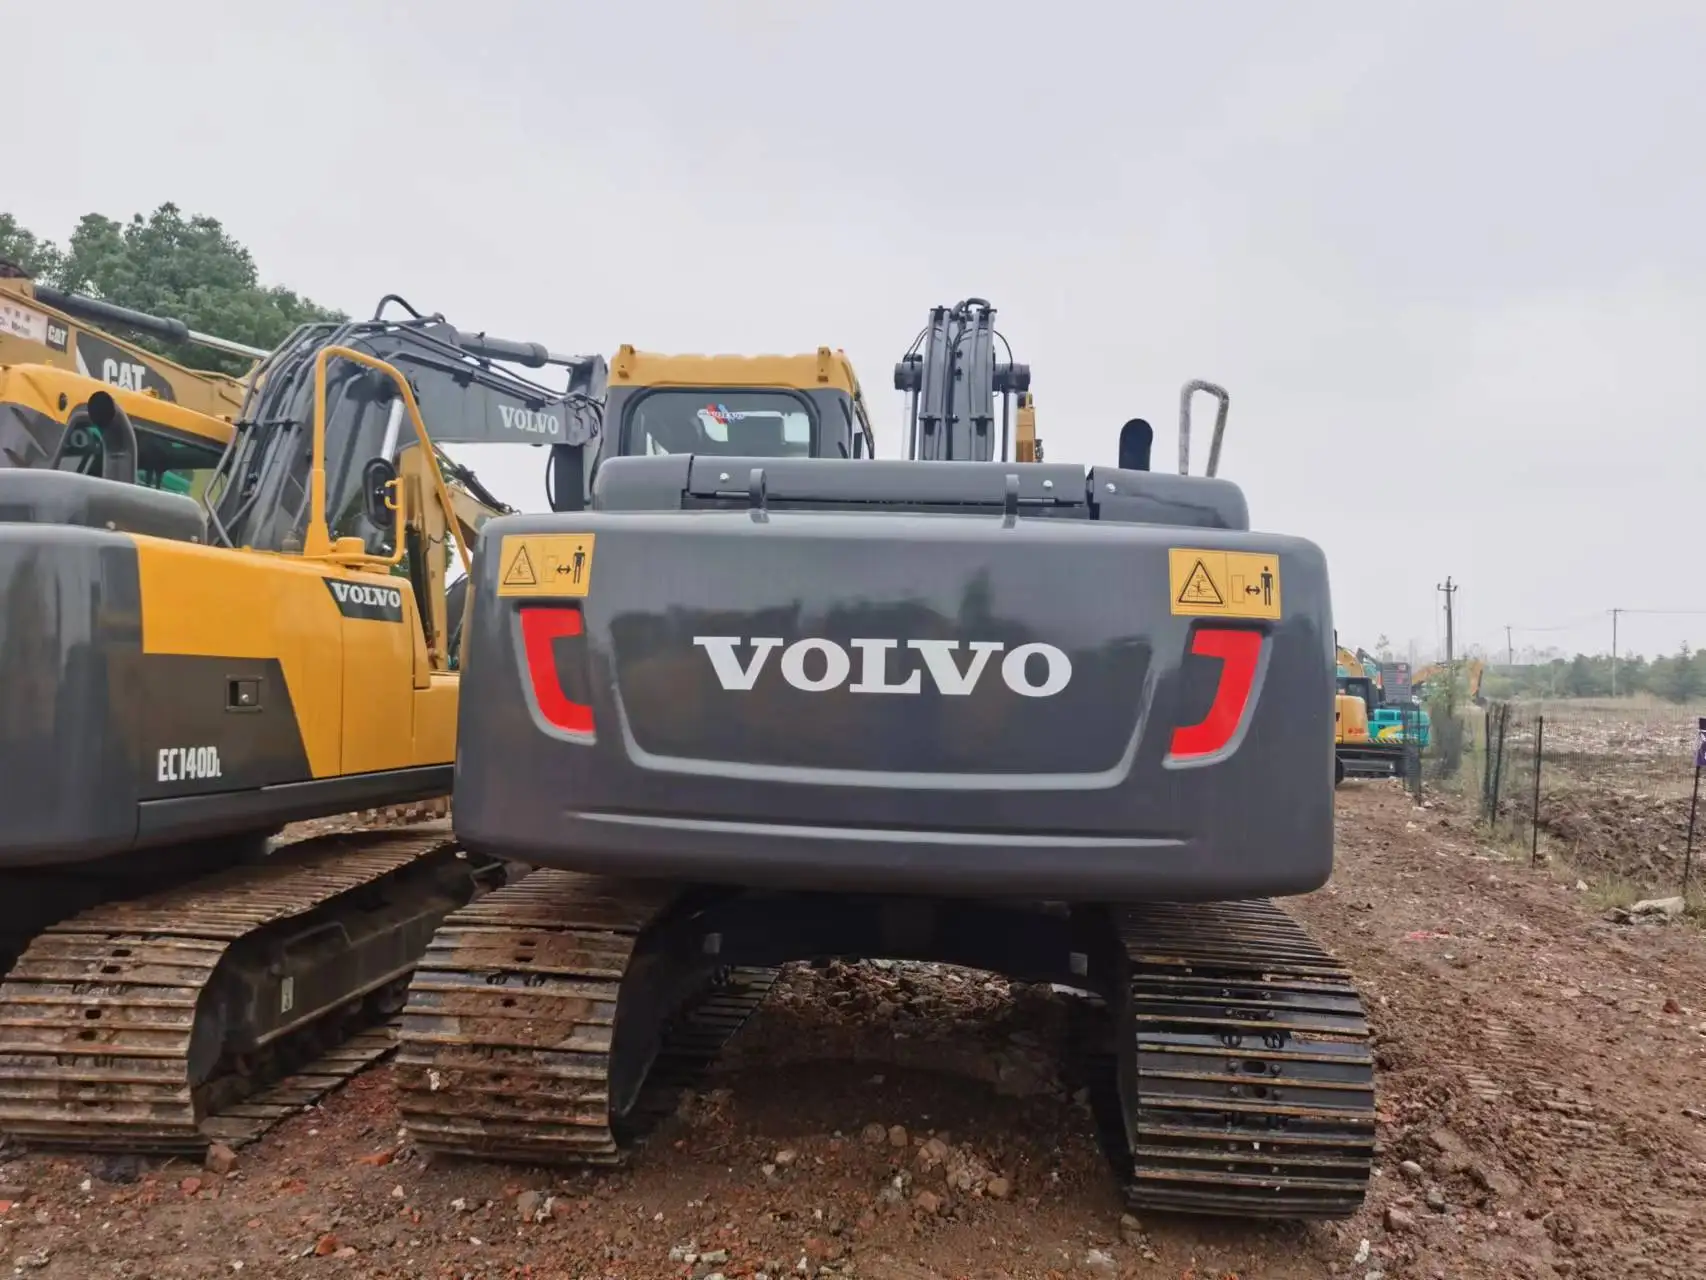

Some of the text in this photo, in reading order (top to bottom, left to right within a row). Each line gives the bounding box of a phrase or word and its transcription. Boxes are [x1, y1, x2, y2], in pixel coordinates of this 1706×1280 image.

[48, 325, 67, 345] CAT
[103, 358, 146, 392] CAT
[498, 405, 560, 434] VOLVO
[331, 582, 402, 608] VOLVO
[692, 635, 1073, 698] VOLVO
